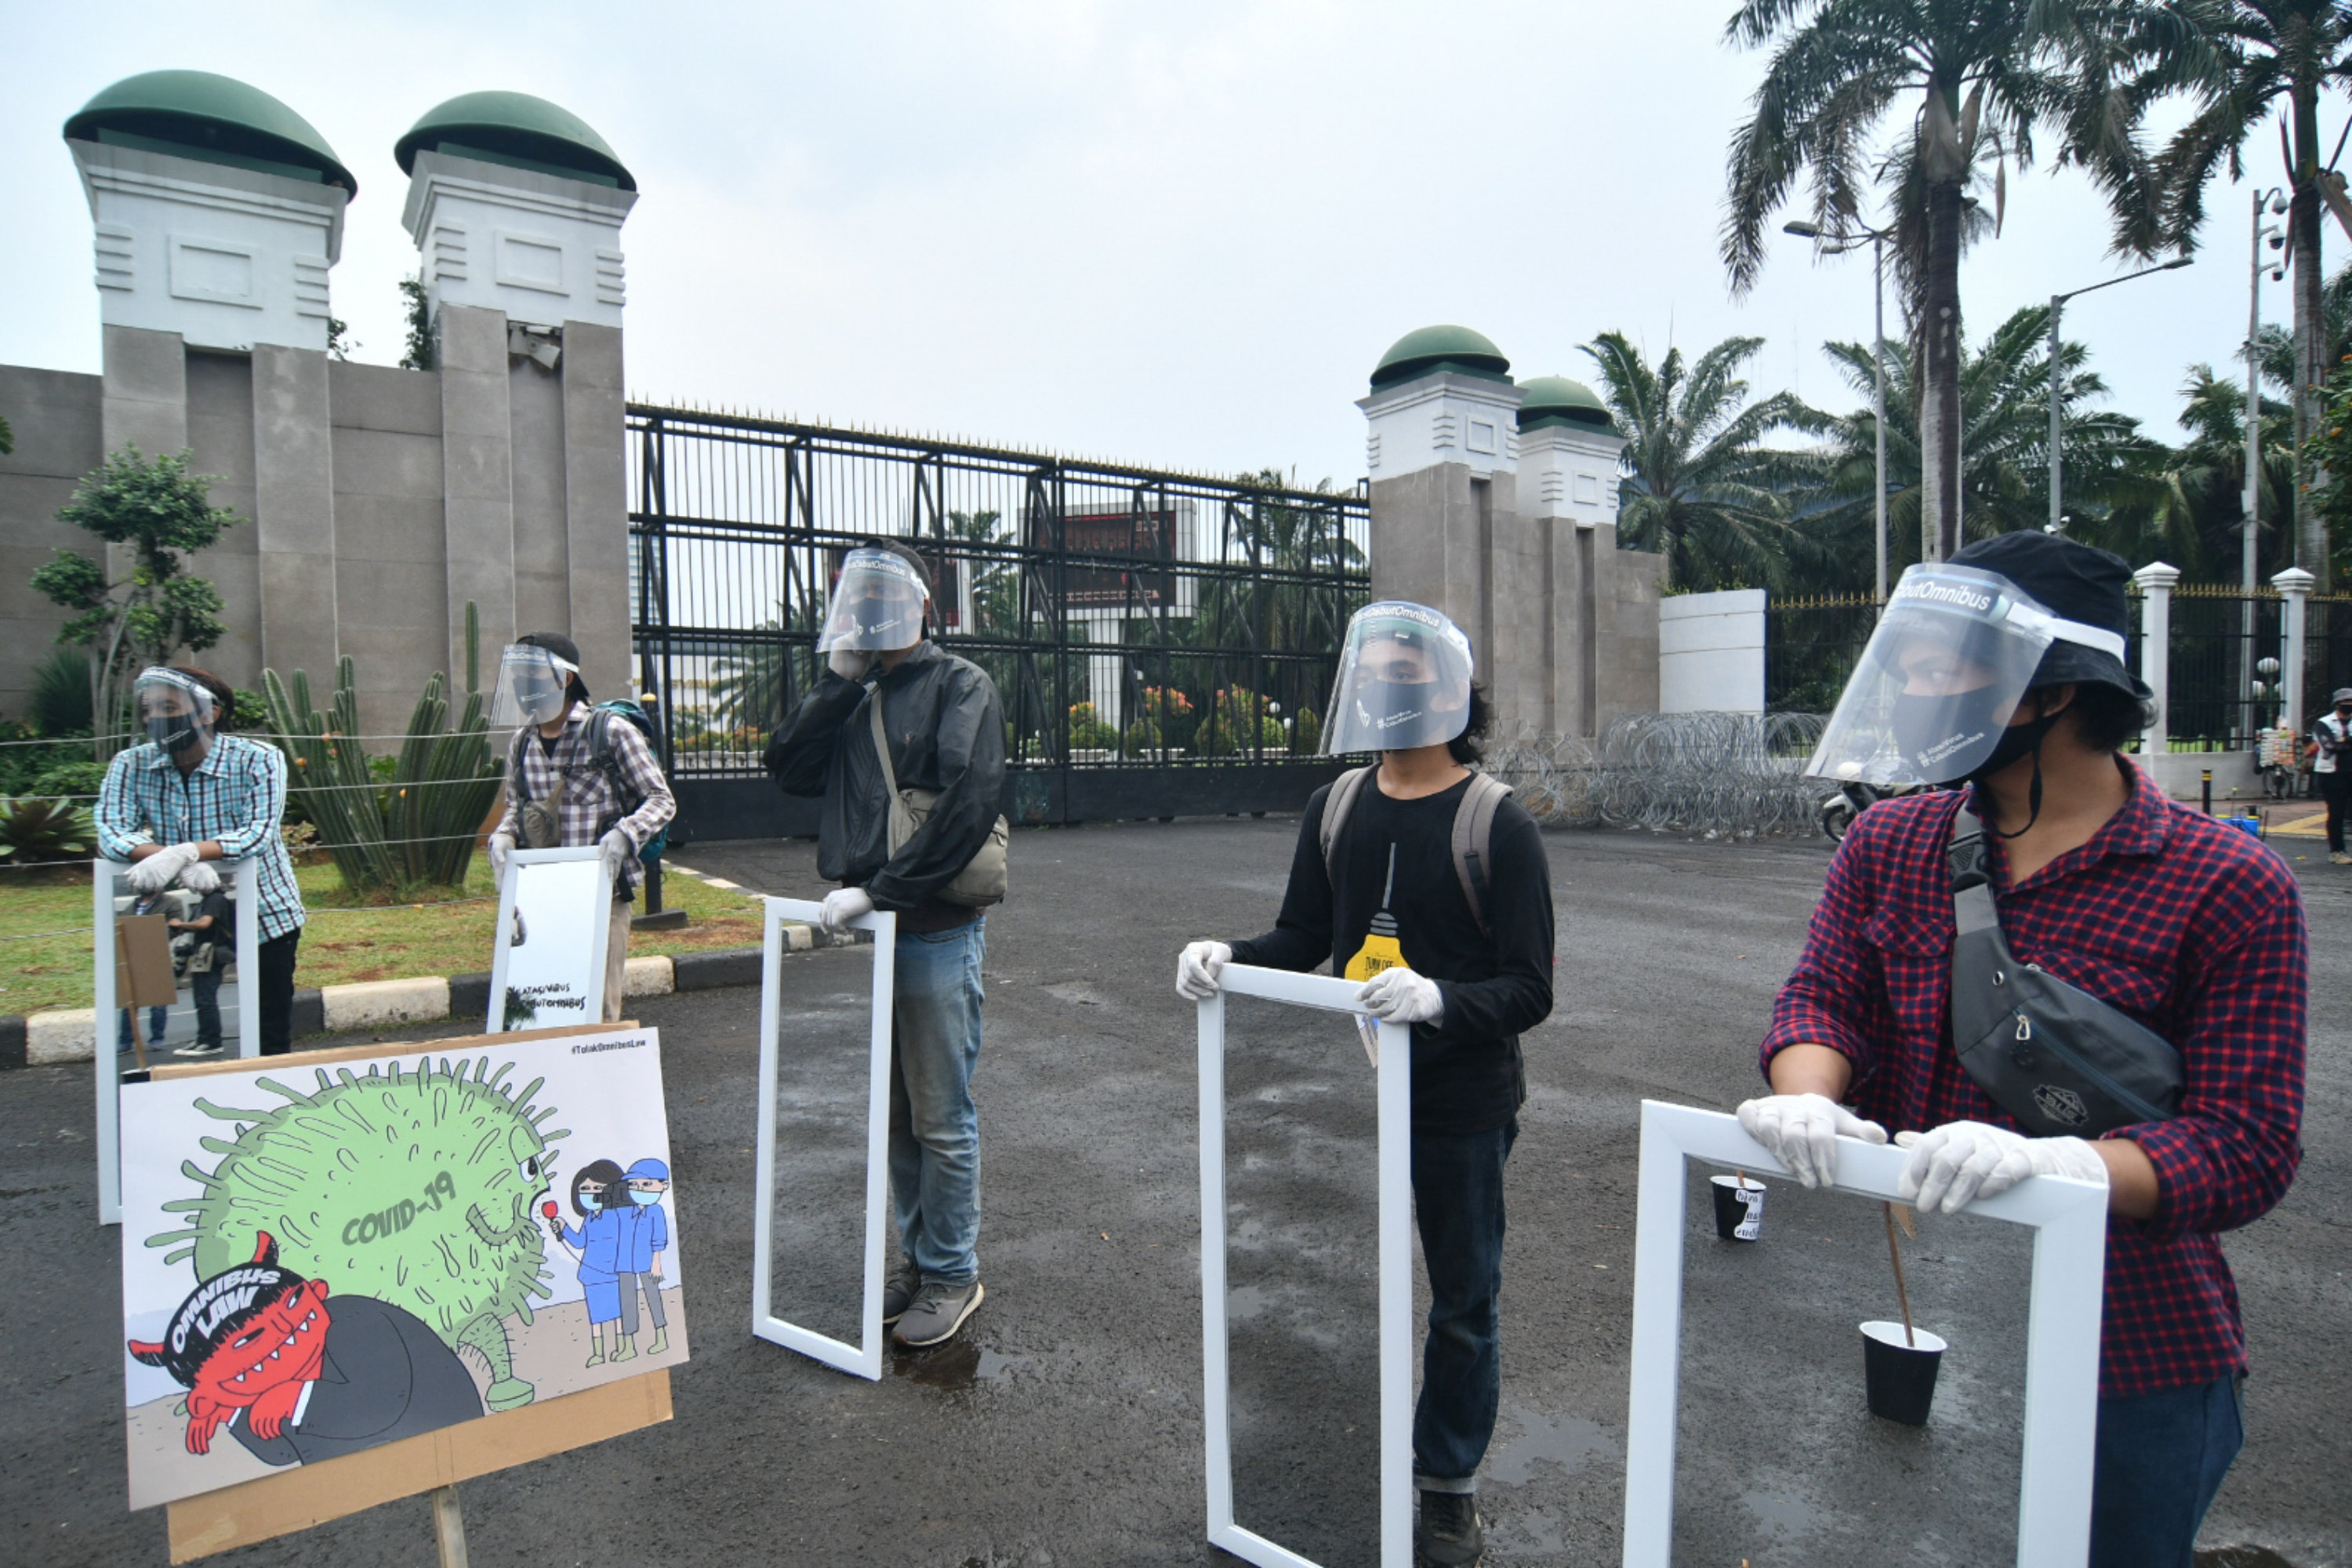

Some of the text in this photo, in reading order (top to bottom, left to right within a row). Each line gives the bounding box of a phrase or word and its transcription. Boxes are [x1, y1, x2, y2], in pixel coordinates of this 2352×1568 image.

[572, 1038, 646, 1055] #TolakOmnibusLaw
[342, 1170, 456, 1246] COVID-19
[172, 1268, 281, 1355] OMNIBUS
[195, 1286, 260, 1340] LAW
